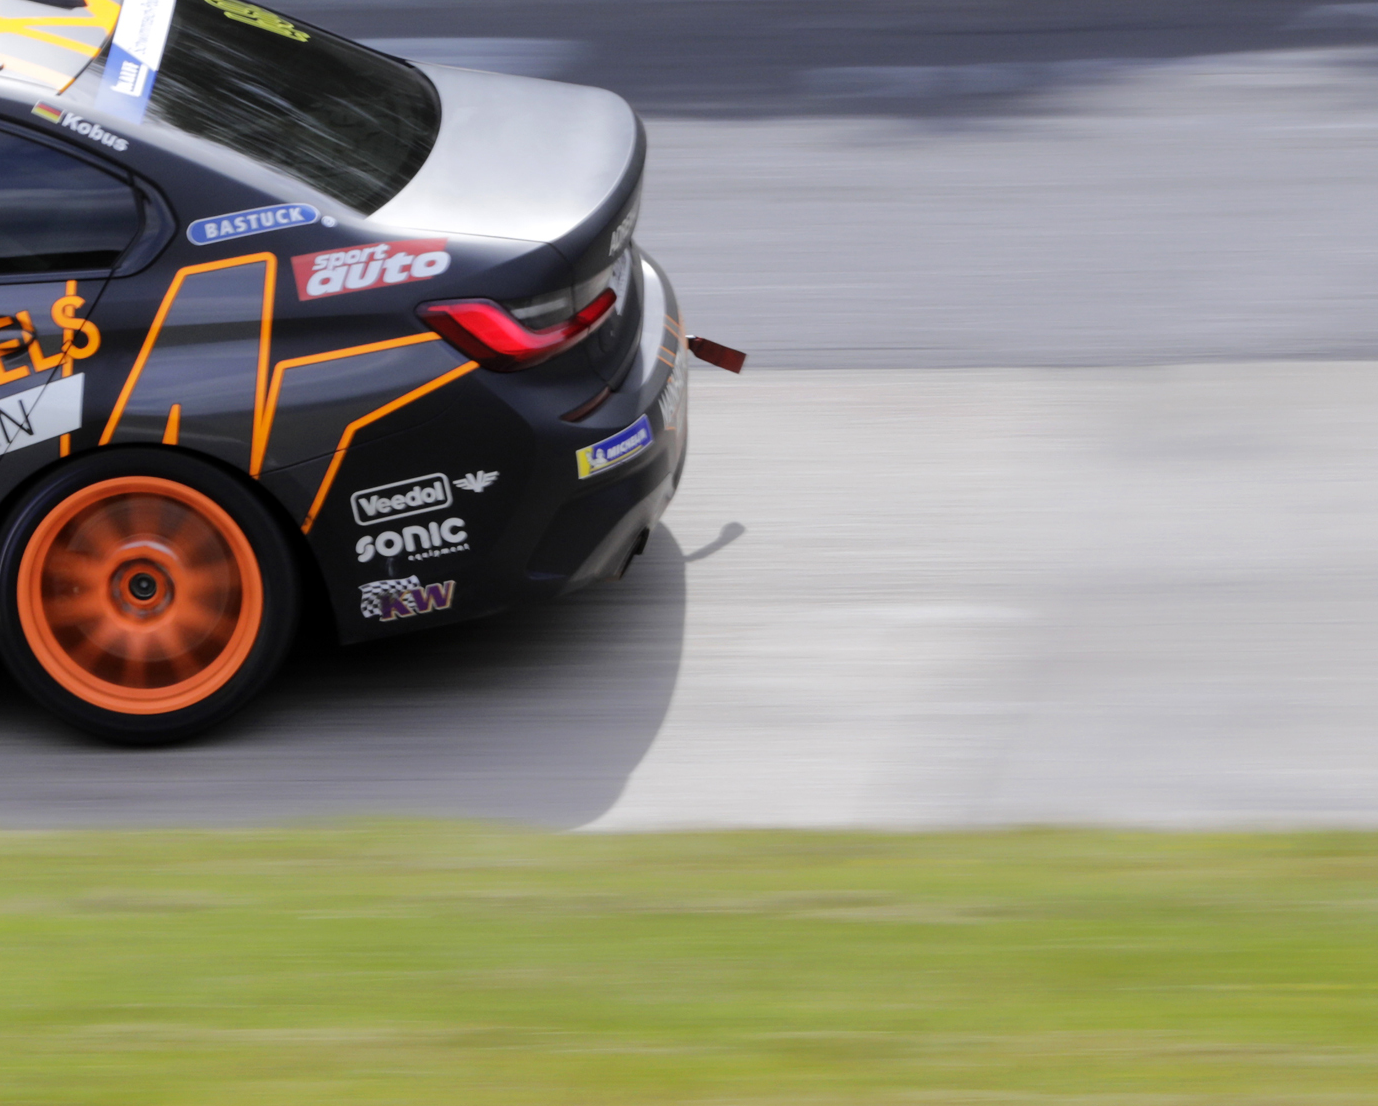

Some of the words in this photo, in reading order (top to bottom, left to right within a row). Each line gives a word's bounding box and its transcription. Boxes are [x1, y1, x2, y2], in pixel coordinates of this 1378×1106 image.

[60, 111, 130, 153] Kobus
[204, 207, 305, 240] BASTUCK
[306, 250, 451, 297] auto
[312, 243, 392, 272] sport
[358, 481, 445, 516] Veedol
[407, 543, 470, 561] equipment
[379, 580, 456, 622] KW
